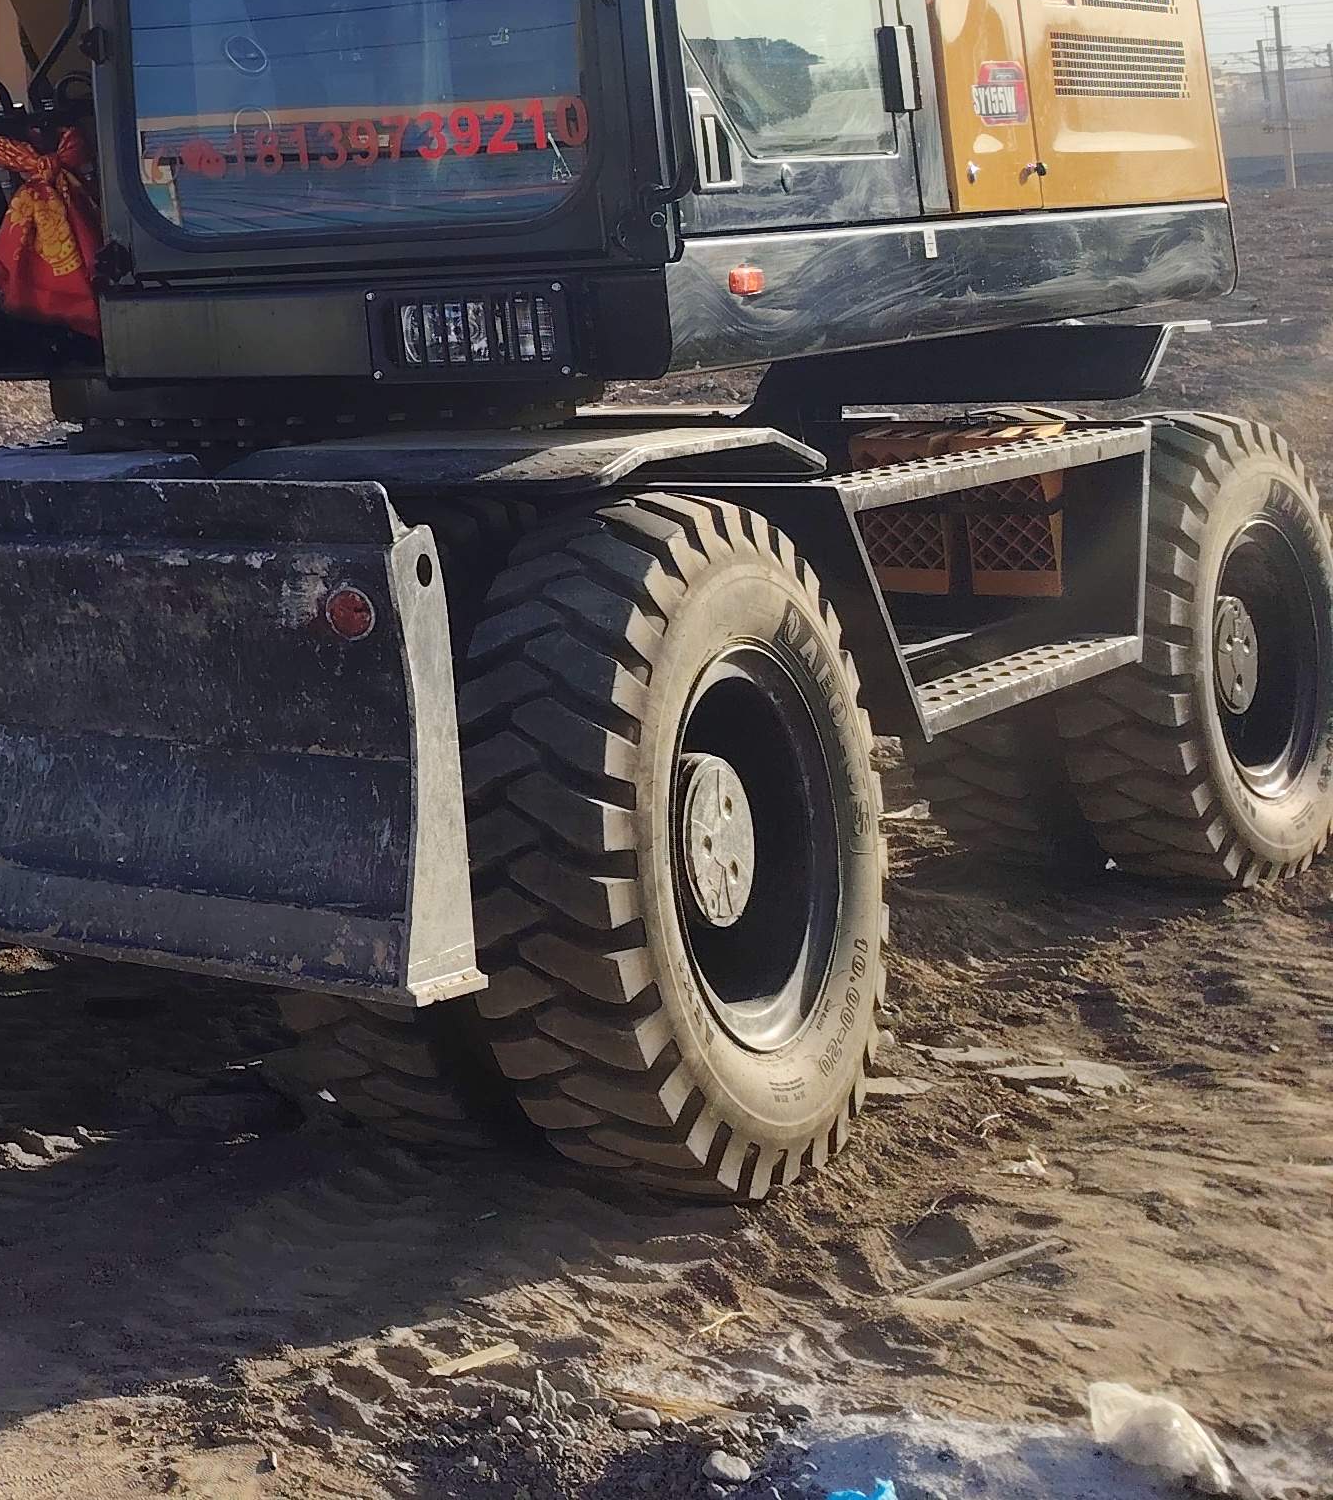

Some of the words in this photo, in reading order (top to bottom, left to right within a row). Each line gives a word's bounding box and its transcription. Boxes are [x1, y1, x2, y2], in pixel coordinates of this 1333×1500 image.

[226, 95, 589, 178] 18139739210
[971, 85, 1017, 116] SY155W
[818, 937, 869, 1078] 10.00-20
